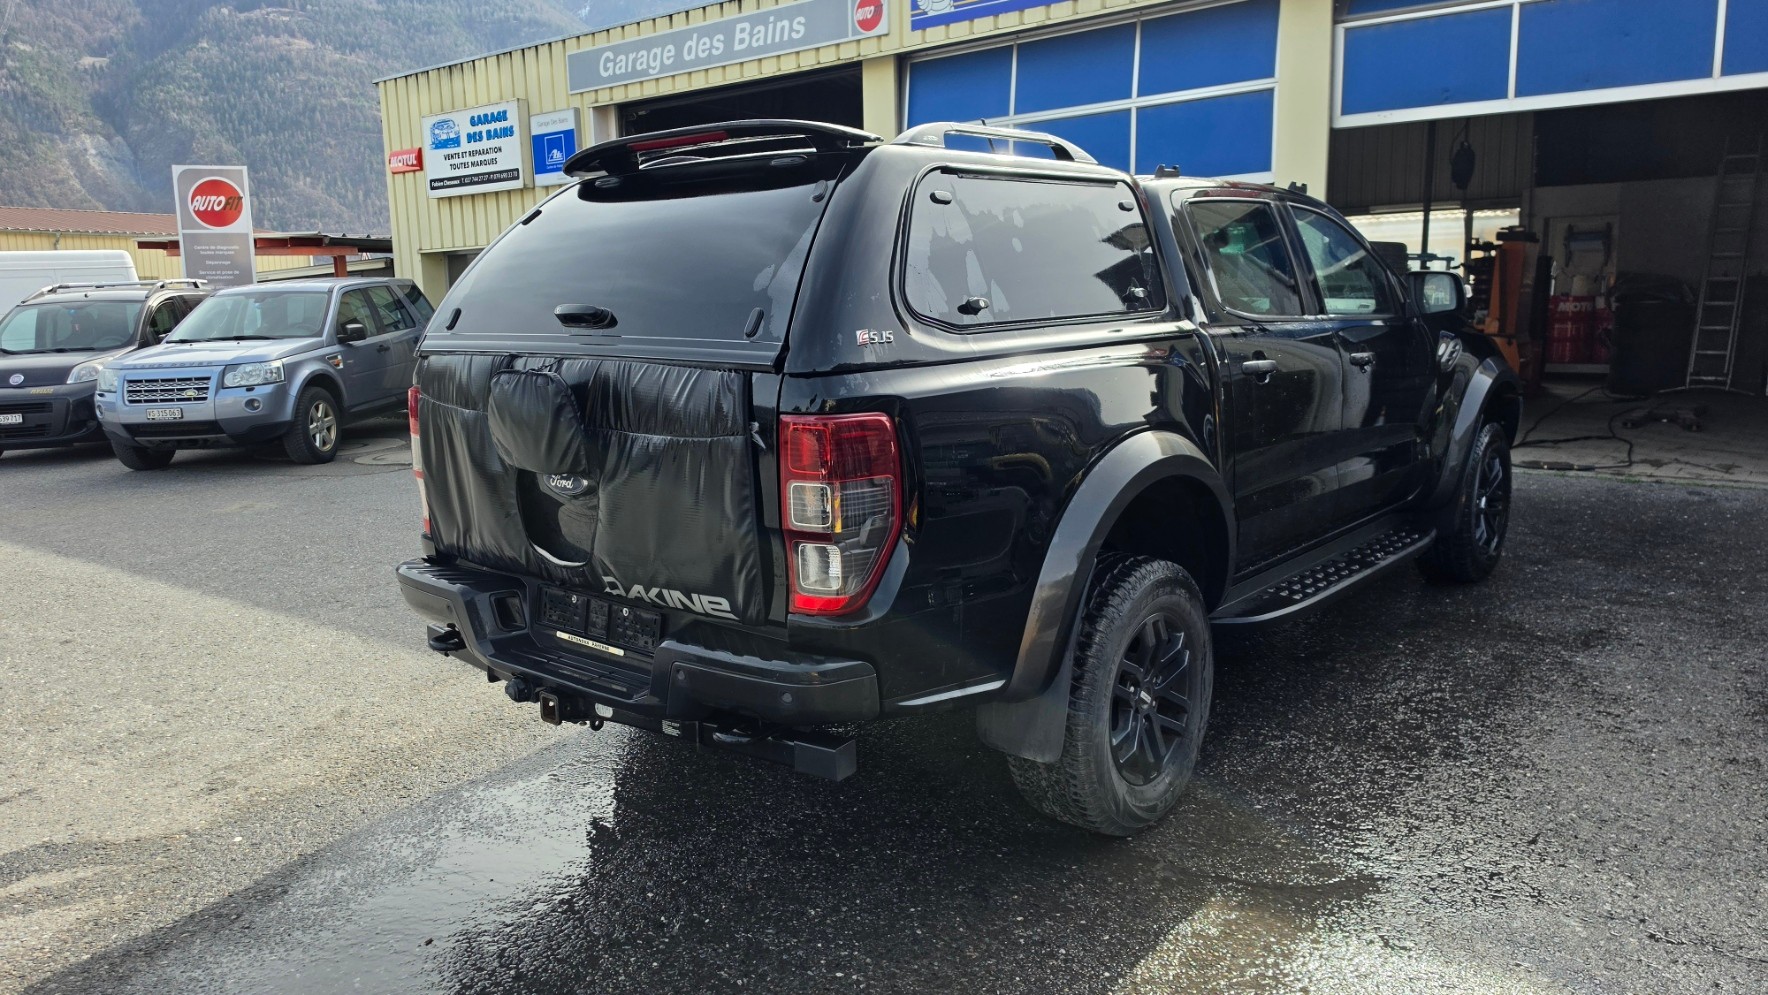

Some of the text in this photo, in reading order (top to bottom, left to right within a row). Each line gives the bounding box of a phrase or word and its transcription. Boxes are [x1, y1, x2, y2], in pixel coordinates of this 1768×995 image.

[599, 16, 806, 78] Garage des Bains
[470, 110, 508, 126] GARAGE
[466, 125, 514, 144] DES BAINS
[390, 154, 417, 167] MOTUL
[444, 152, 460, 161] VENTE
[468, 146, 502, 158] REPARATION
[449, 158, 498, 170] TOUTES MARQUES
[192, 195, 243, 211] AUTOFIT
[550, 474, 574, 488] Ford
[602, 576, 740, 620] DAKINE
